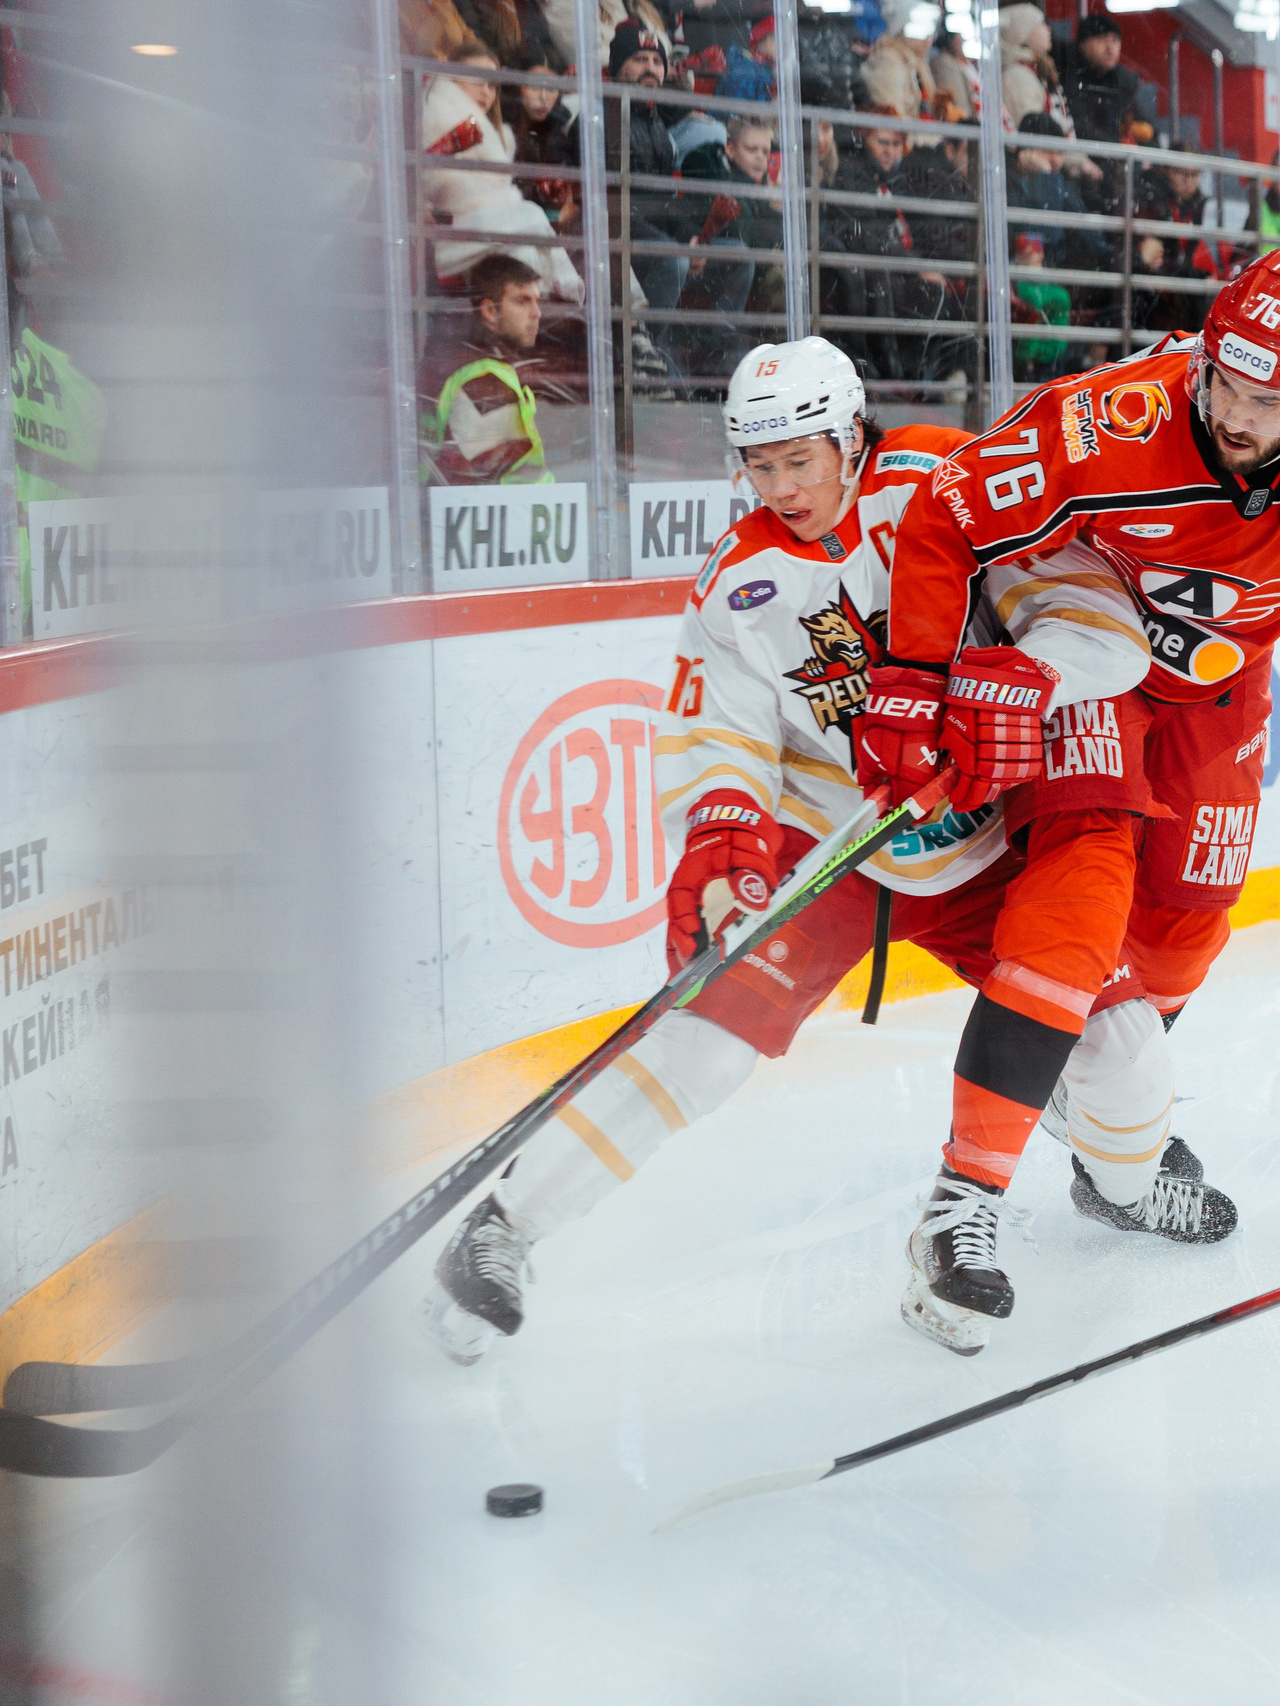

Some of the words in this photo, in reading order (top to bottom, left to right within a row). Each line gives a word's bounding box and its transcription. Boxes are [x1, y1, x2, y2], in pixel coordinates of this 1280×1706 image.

[755, 360, 779, 377] 15
[1062, 396, 1084, 463] UMMC
[1077, 388, 1100, 459] УГМК
[881, 454, 937, 470] SIBUR
[979, 427, 1046, 511] 76
[943, 488, 975, 529] РМК
[444, 502, 577, 571] KHL.RU
[1141, 617, 1185, 658] ne
[800, 672, 872, 734] RED
[946, 675, 1042, 710] ARRIOR
[1043, 700, 1120, 740] SIMA
[1044, 736, 1123, 781] LAND
[1192, 805, 1254, 844] SIMA
[1182, 842, 1250, 886] LAND
